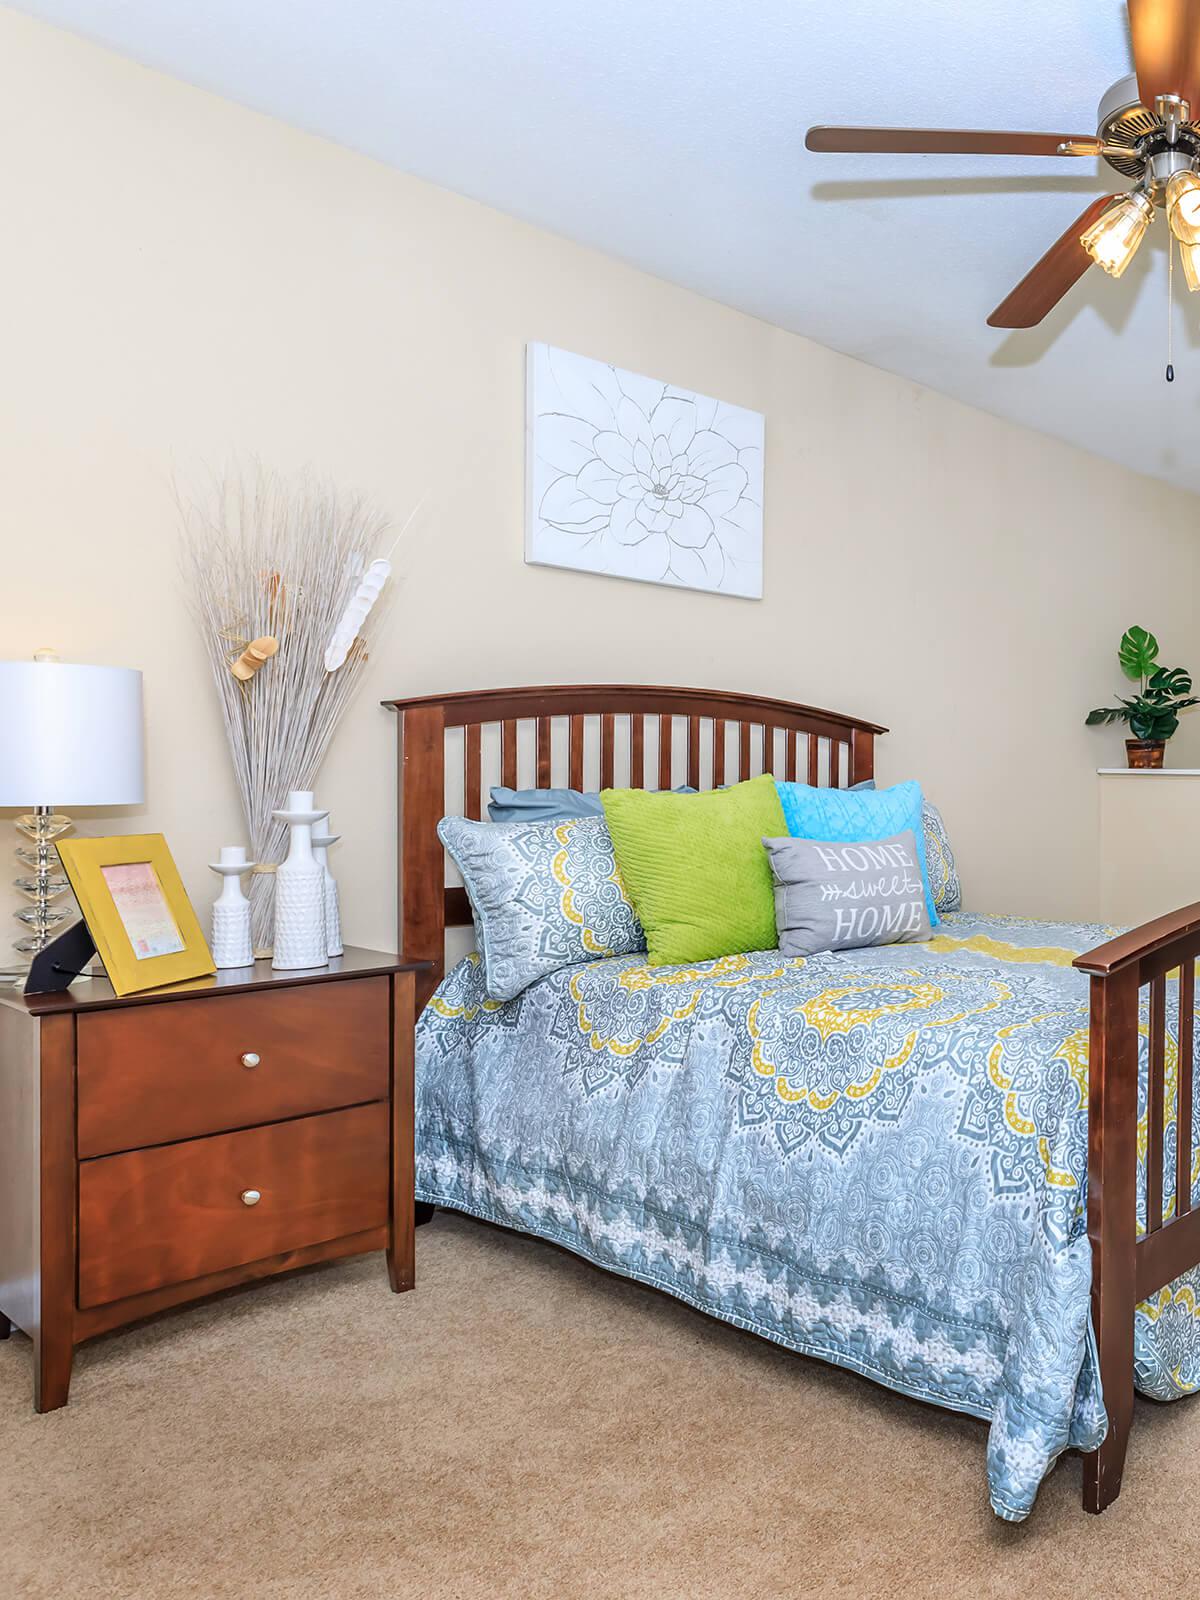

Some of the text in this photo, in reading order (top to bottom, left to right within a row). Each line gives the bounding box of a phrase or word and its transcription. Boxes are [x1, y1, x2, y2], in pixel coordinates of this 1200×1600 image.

[813, 843, 914, 872] HOME
[846, 869, 914, 899] sweet
[831, 901, 923, 942] HOME
